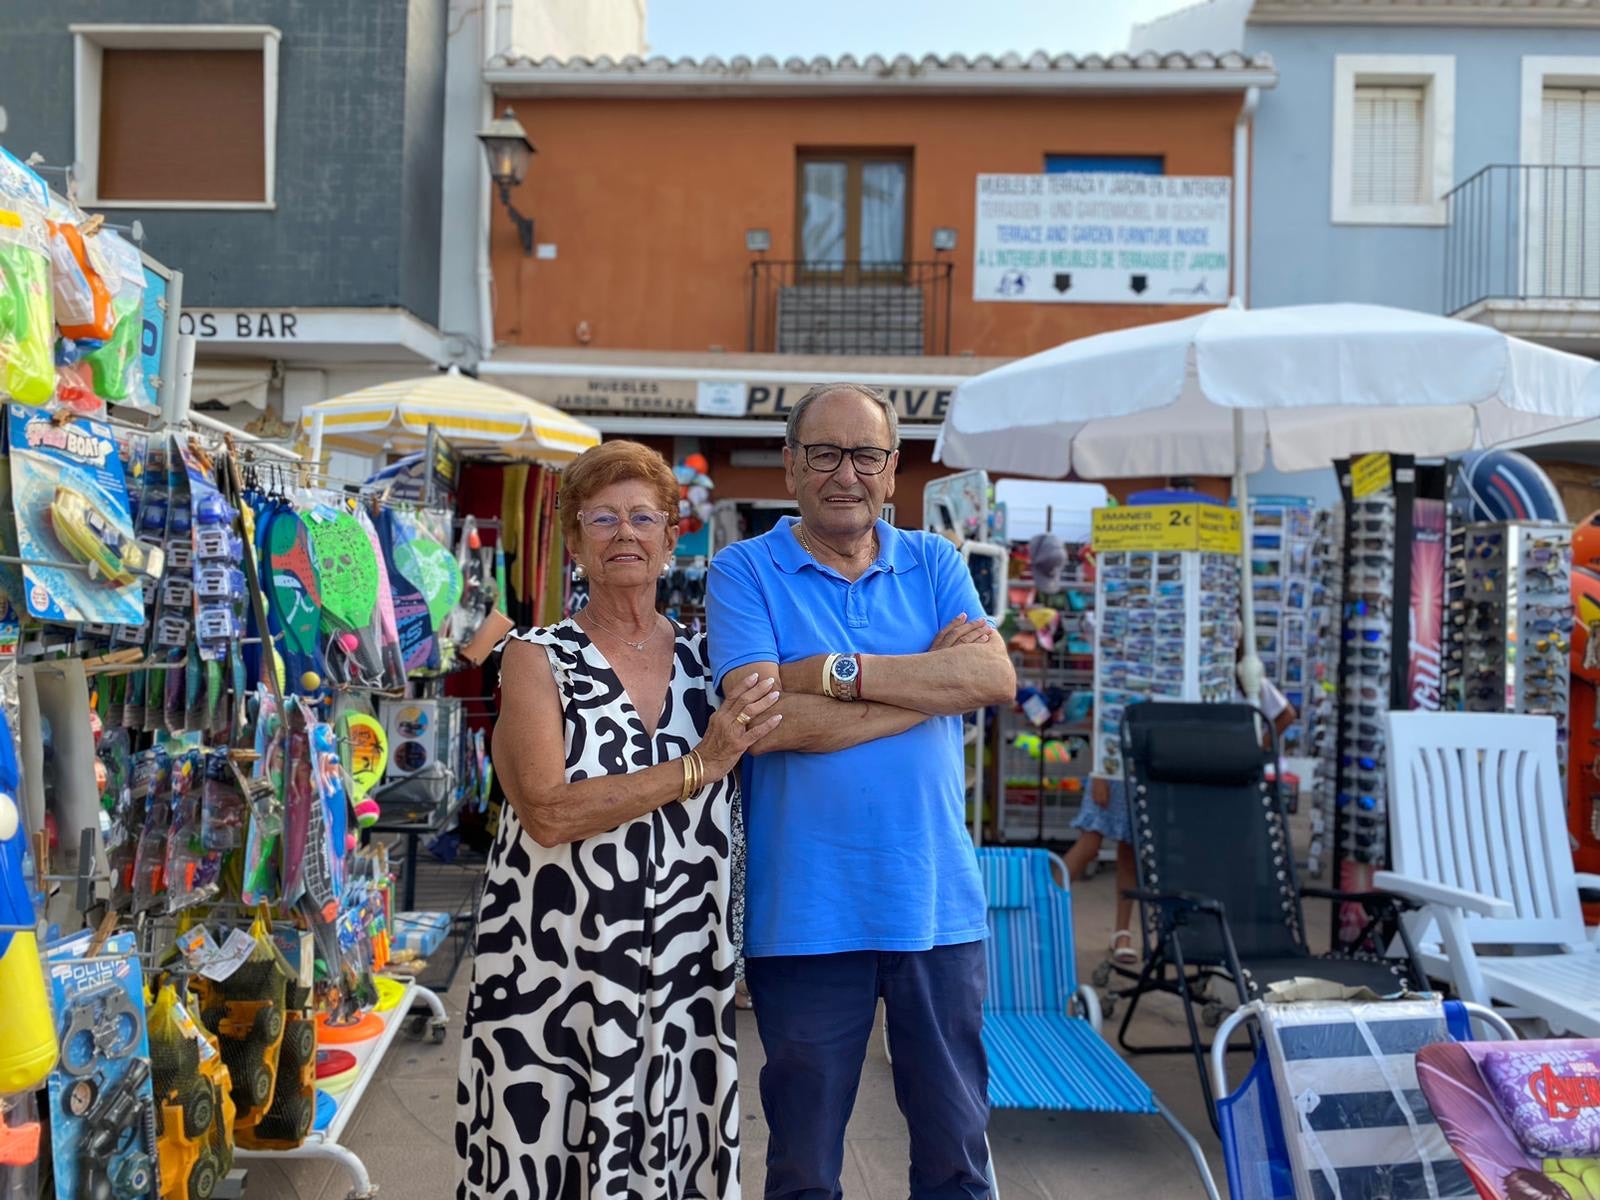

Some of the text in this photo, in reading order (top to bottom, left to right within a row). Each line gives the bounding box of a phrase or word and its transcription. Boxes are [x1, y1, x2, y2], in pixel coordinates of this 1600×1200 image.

[997, 225, 1208, 246] TERRACE AND GARDEN FURNITURE INSIDE
[236, 312, 298, 338] BAR
[588, 381, 659, 394] MUEBLES
[623, 396, 697, 410] TERRAZA
